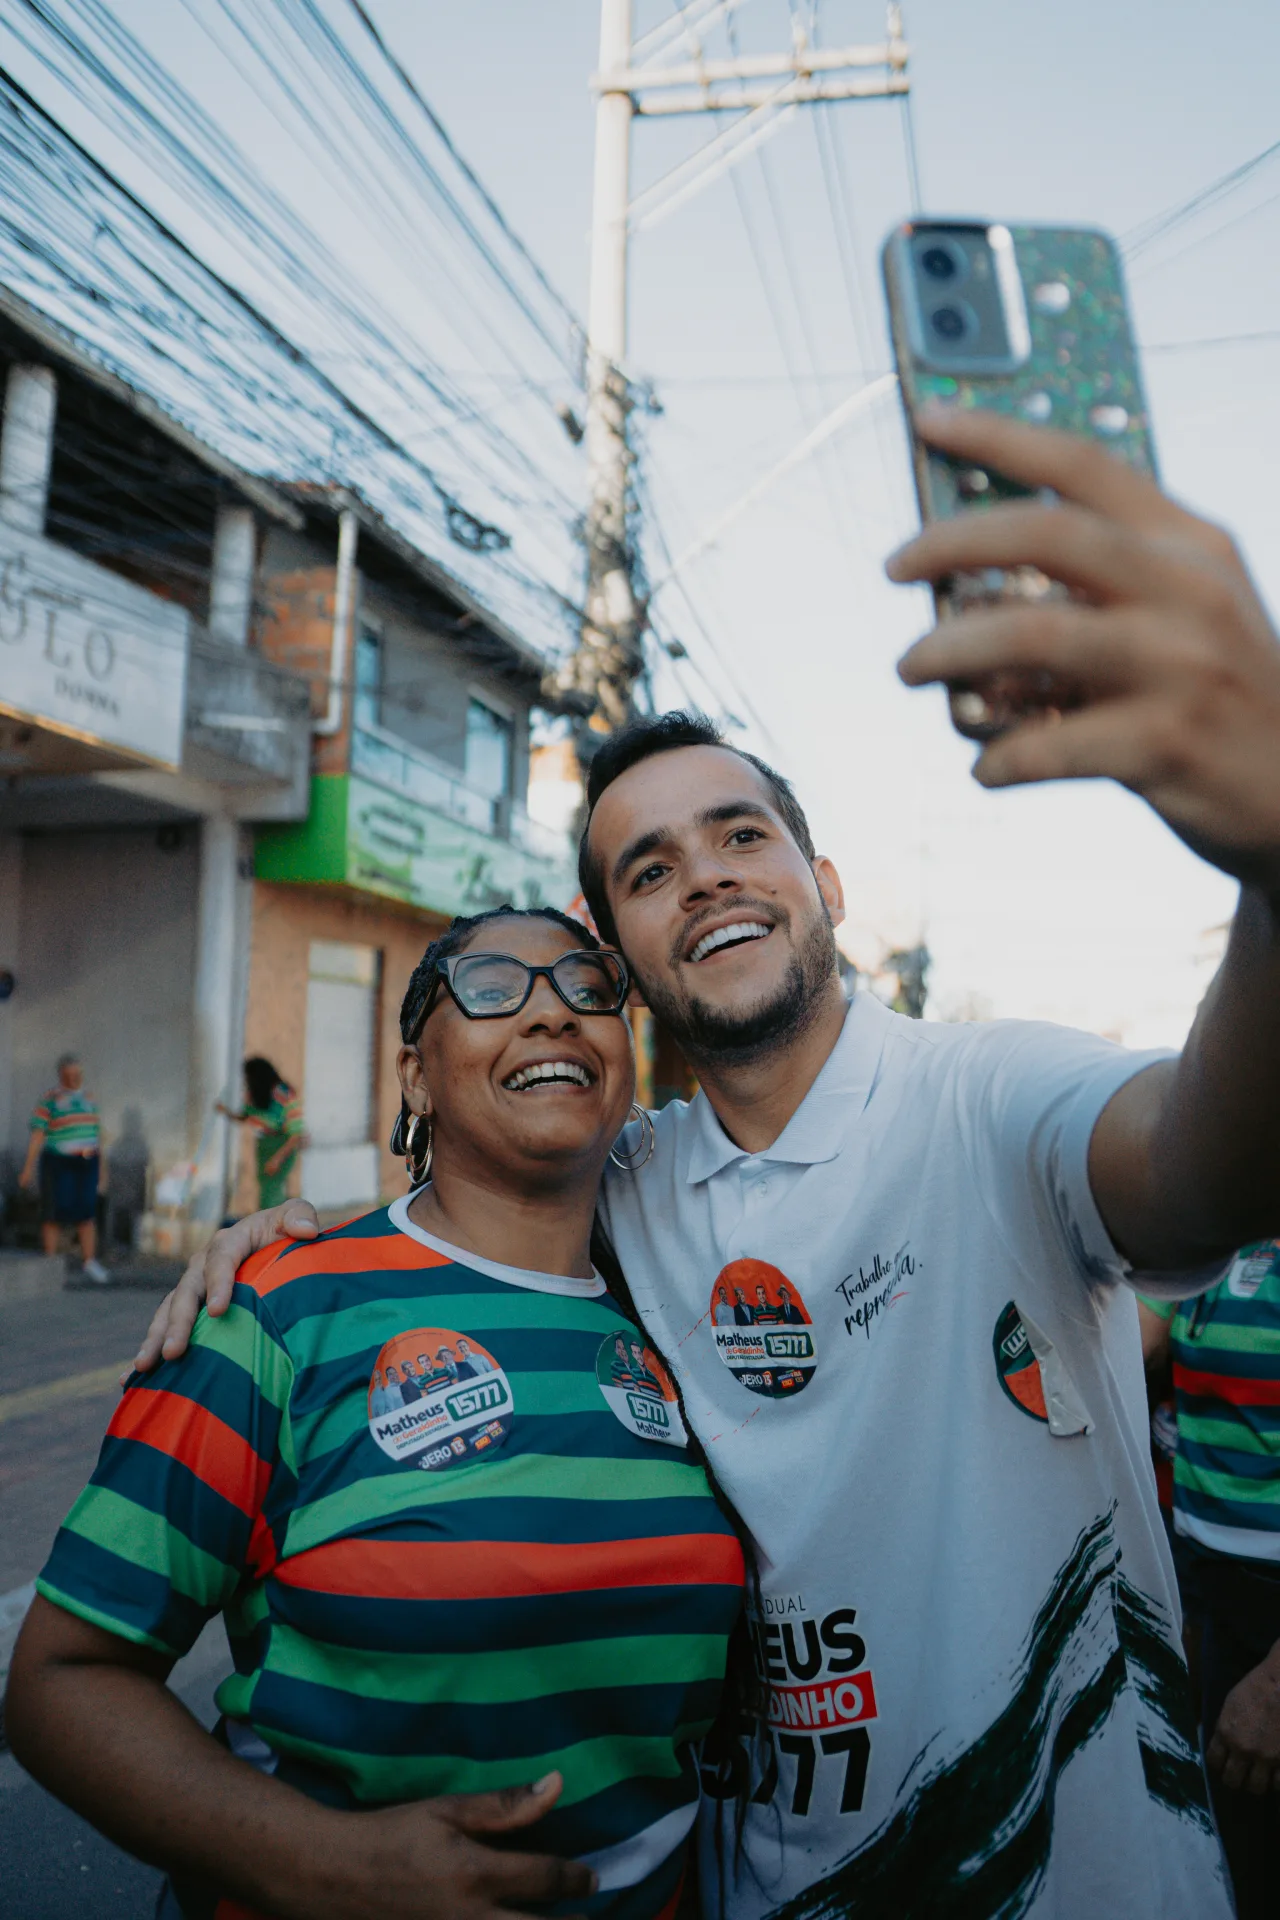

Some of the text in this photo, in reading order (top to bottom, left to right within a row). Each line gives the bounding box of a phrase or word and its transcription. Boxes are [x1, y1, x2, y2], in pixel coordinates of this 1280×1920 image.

[835, 1253, 892, 1307] Trabalho
[717, 1333, 763, 1347] Matheus
[741, 1374, 763, 1386] JERO
[448, 1382, 502, 1417] 15777
[376, 1403, 445, 1440] Matheus
[422, 1439, 466, 1469] JERO 13
[761, 1595, 806, 1615] DUAL
